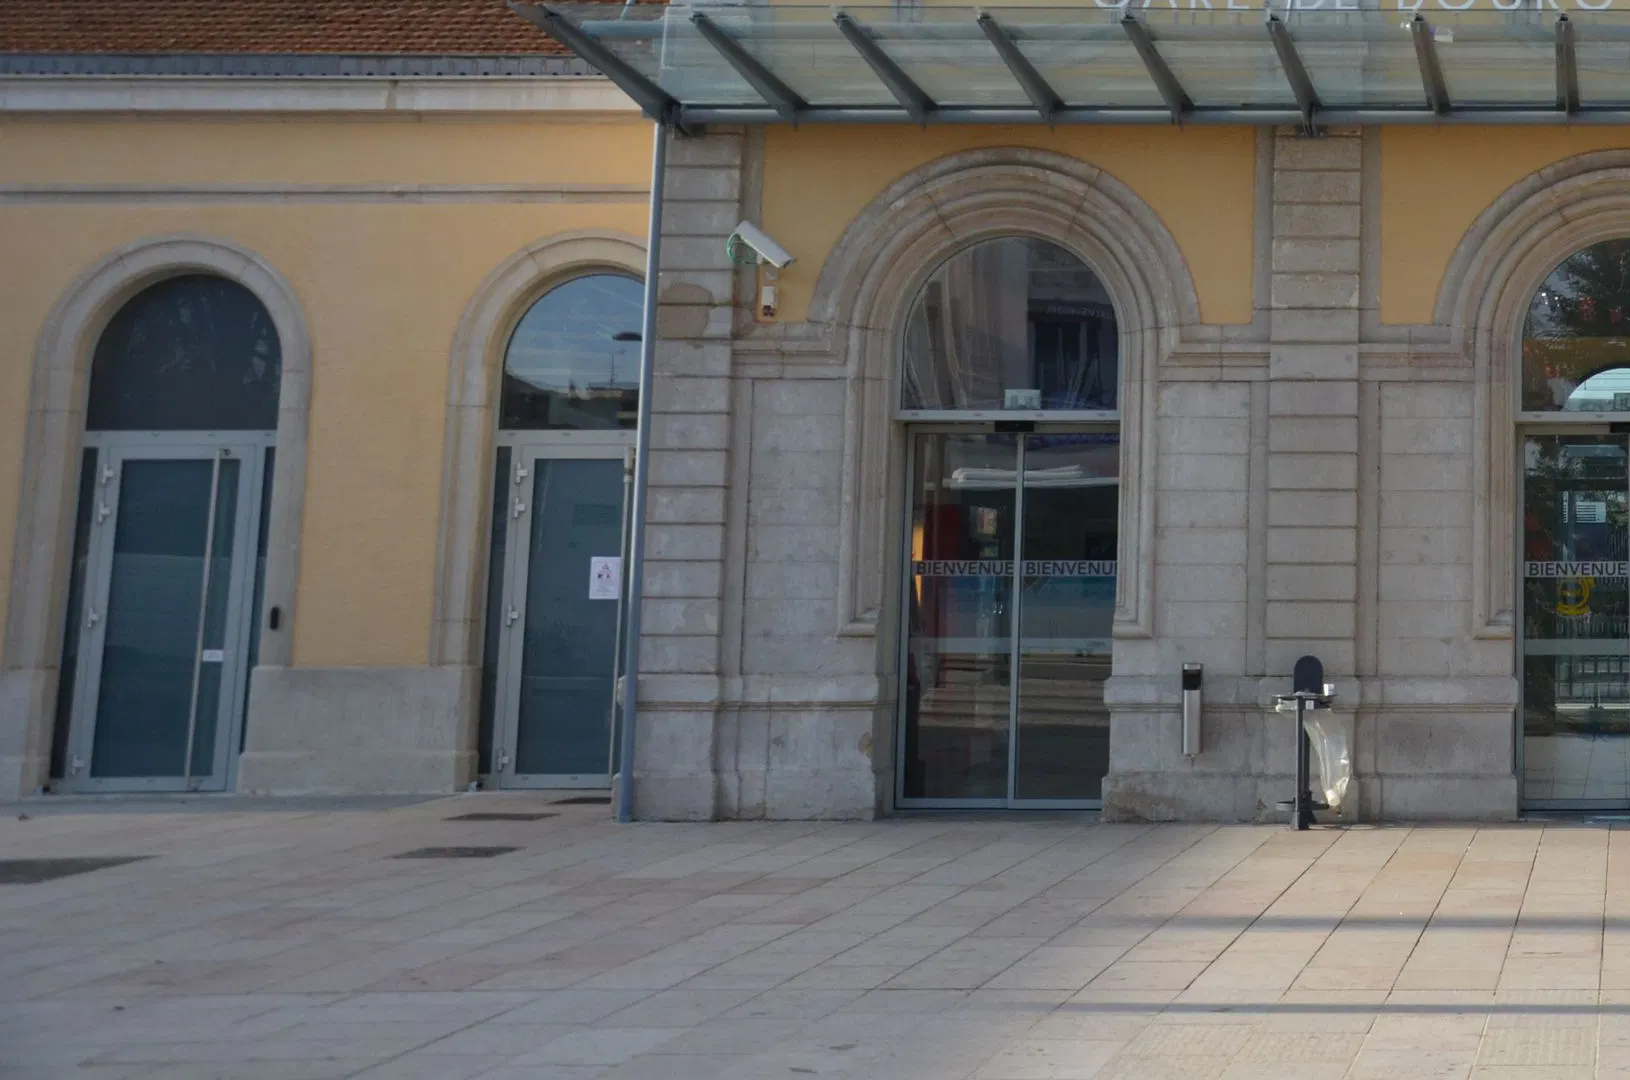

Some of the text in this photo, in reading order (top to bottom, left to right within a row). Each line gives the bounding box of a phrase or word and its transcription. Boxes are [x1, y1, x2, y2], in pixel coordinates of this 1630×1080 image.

[916, 561, 1117, 575] BIENVENUE BIENVENU
[1528, 562, 1627, 576] BIENVENUE
